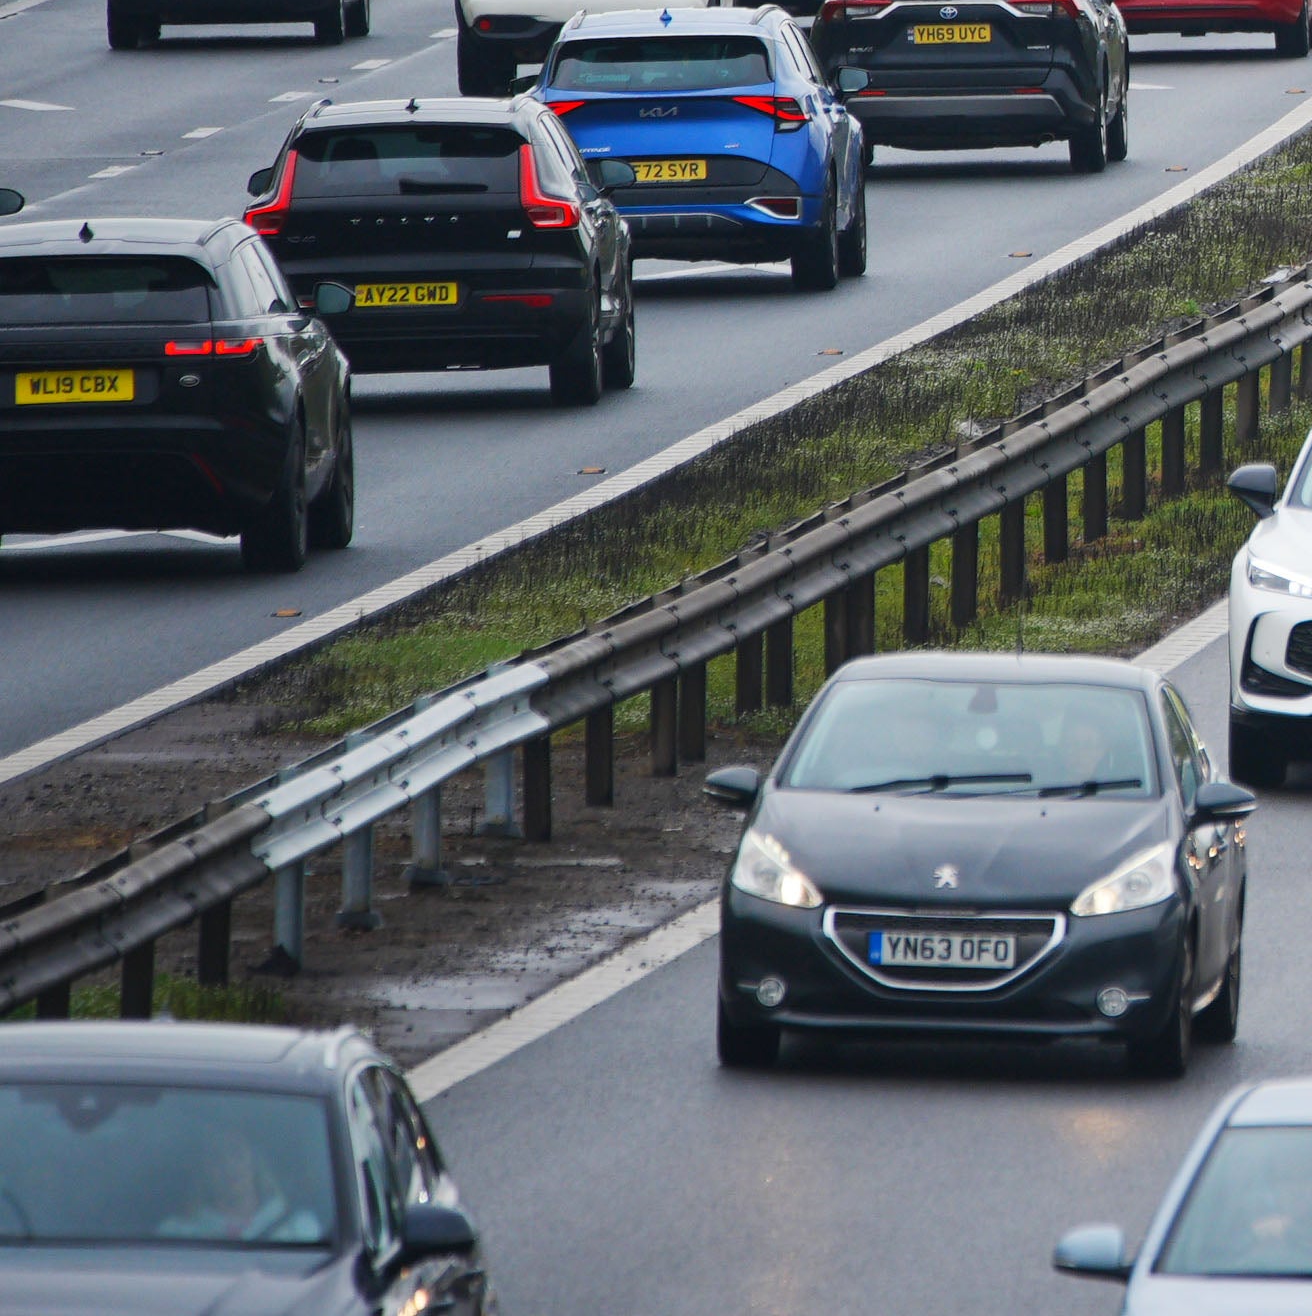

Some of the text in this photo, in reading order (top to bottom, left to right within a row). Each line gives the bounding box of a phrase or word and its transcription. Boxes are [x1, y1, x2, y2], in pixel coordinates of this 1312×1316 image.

[916, 26, 987, 42] YH69 UYC
[668, 162, 699, 177] SYR
[364, 286, 449, 303] AY22 GWD
[30, 375, 119, 394] WL19 CBX
[888, 937, 952, 960] YN63
